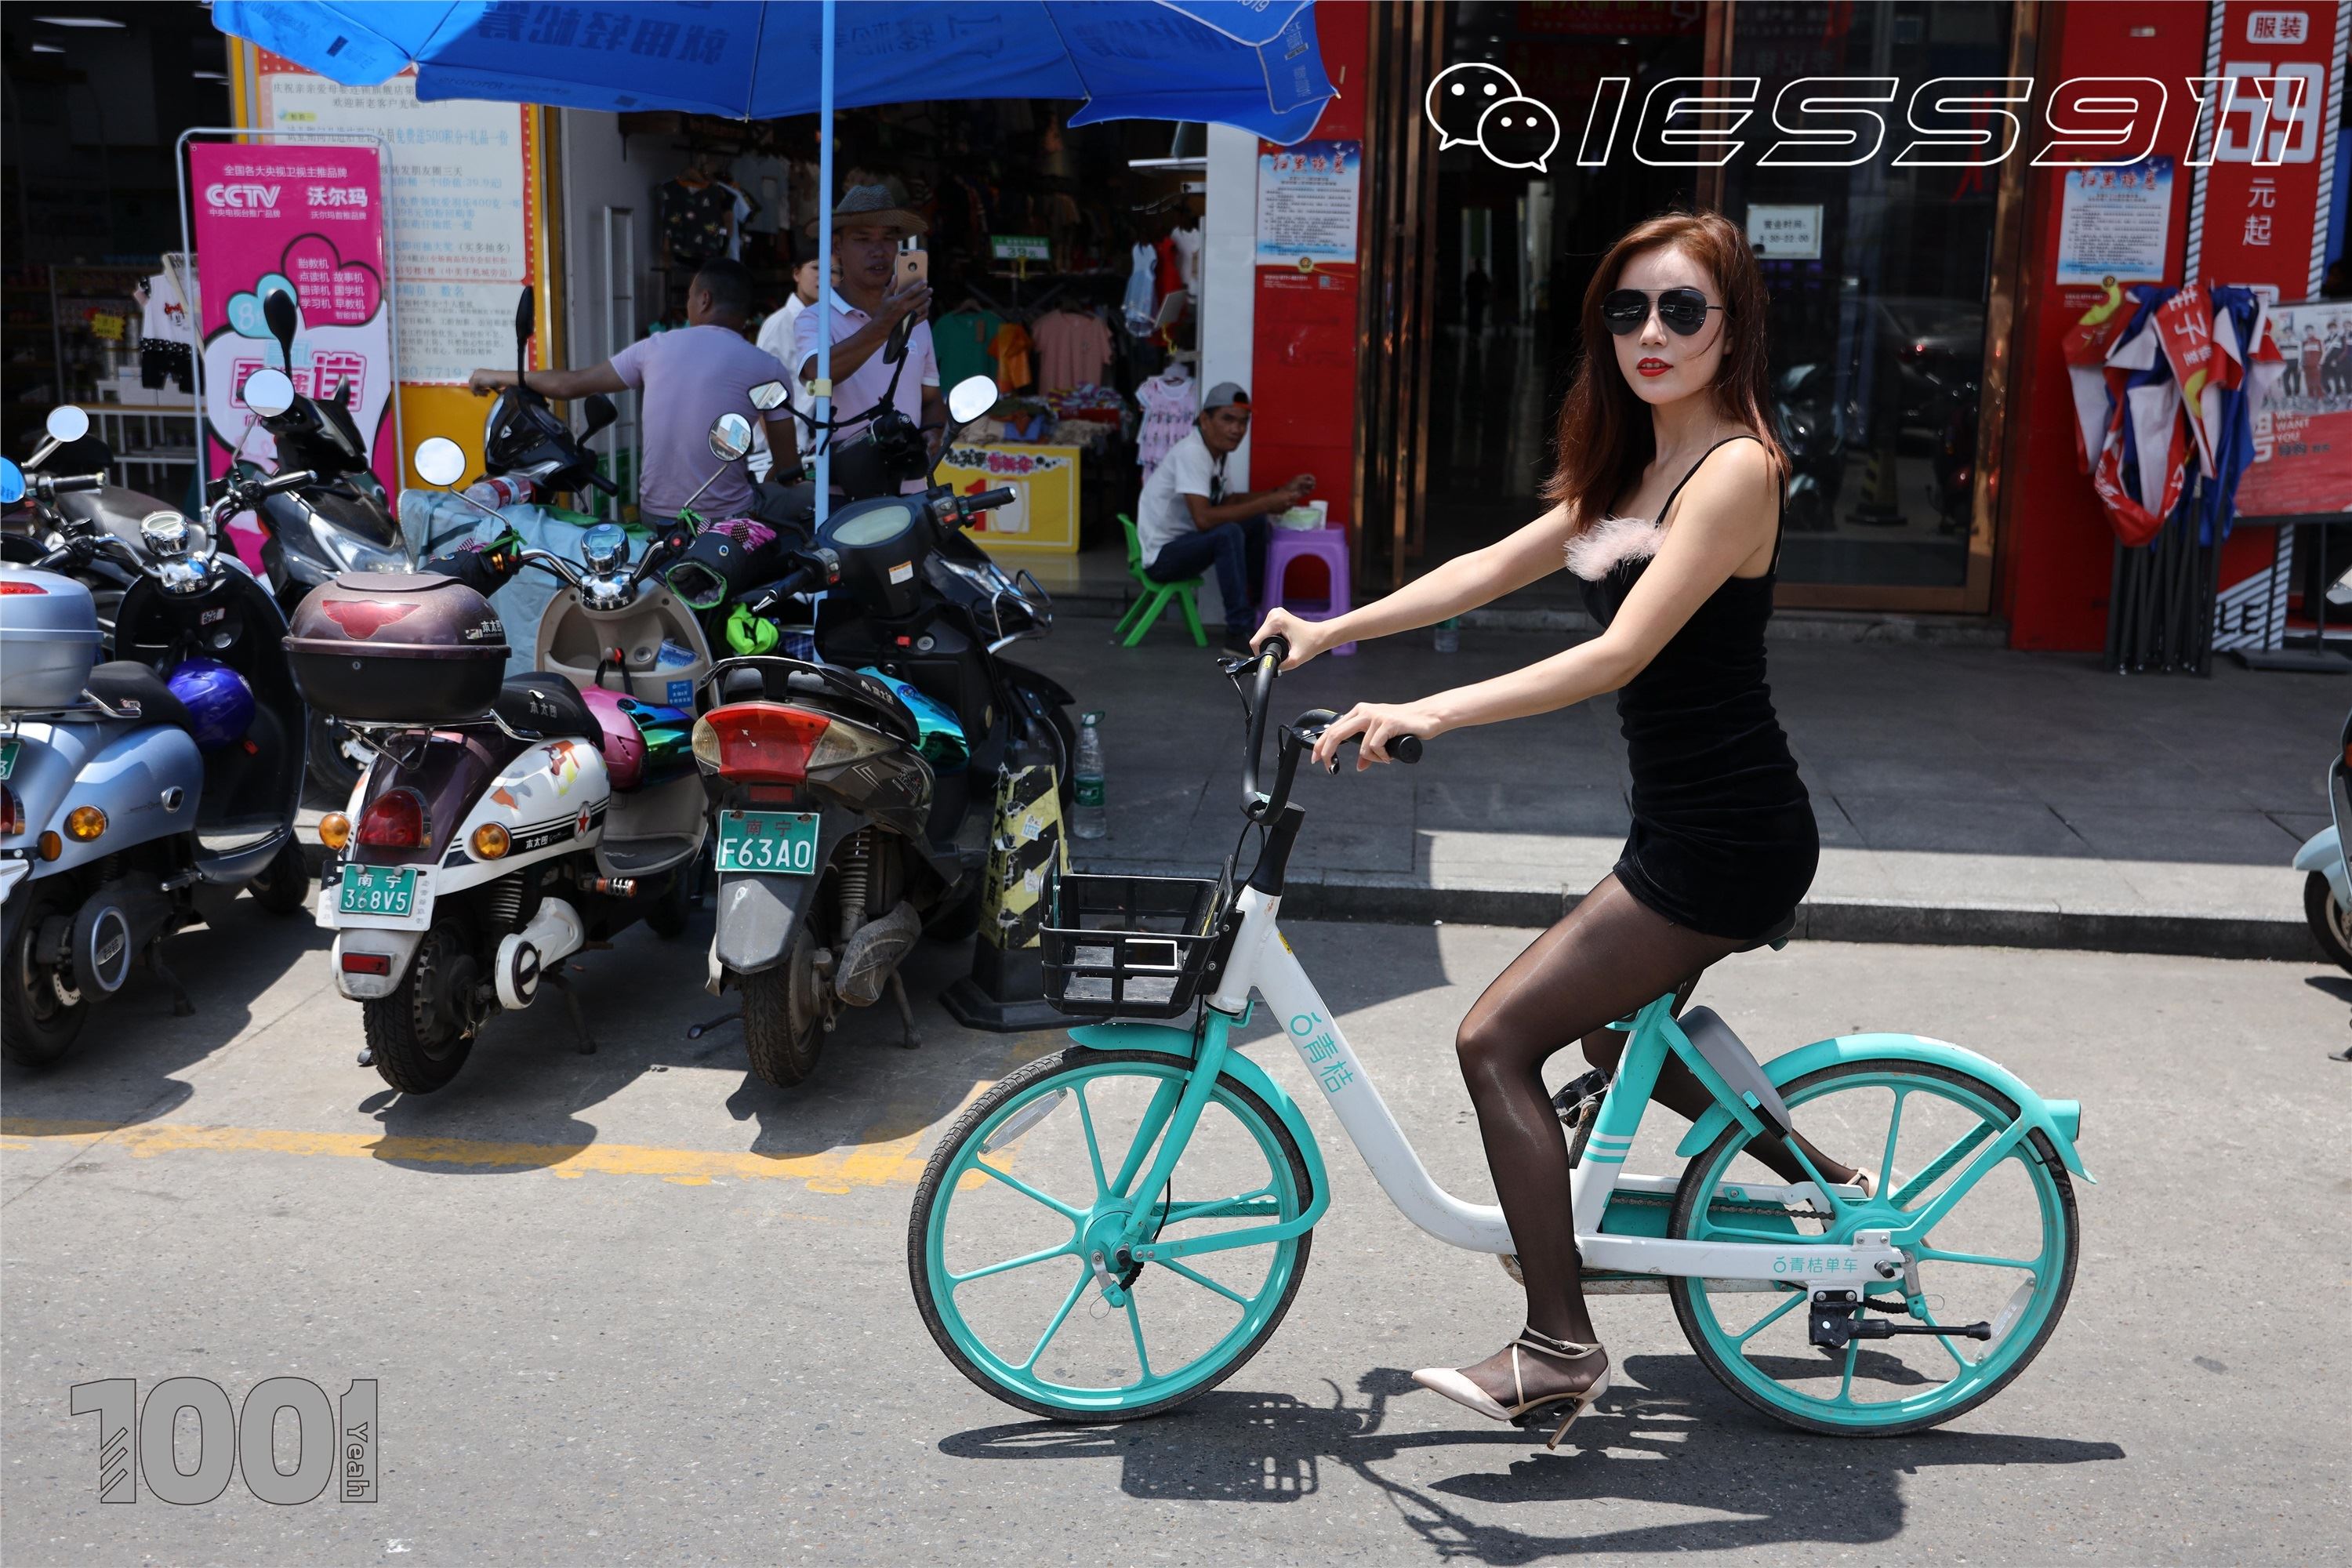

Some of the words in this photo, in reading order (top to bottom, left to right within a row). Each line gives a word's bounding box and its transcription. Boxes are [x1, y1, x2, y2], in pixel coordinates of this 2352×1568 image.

[2253, 16, 2302, 38] 服装
[2216, 61, 2325, 163] 59
[223, 164, 348, 179] 全国各大央视卫视主推品牌
[206, 183, 281, 209] CCTV
[307, 186, 368, 207] 沃尔玛
[209, 209, 281, 218] 中央电视台推广品牌
[310, 211, 366, 220] 沃尔玛首推品牌
[2242, 177, 2277, 247] 元起
[299, 272, 330, 283] 点读机
[333, 272, 364, 283] 故事机
[335, 285, 365, 296] 国学机
[301, 299, 332, 310] 学习机
[335, 299, 365, 310] 早教机
[2276, 418, 2310, 431] WANT
[2277, 432, 2301, 444] YOU
[746, 819, 792, 837] 南宁
[357, 873, 402, 889] 南宁
[344, 888, 408, 911] 368V5
[1789, 1257, 1858, 1273] 青桔单车
